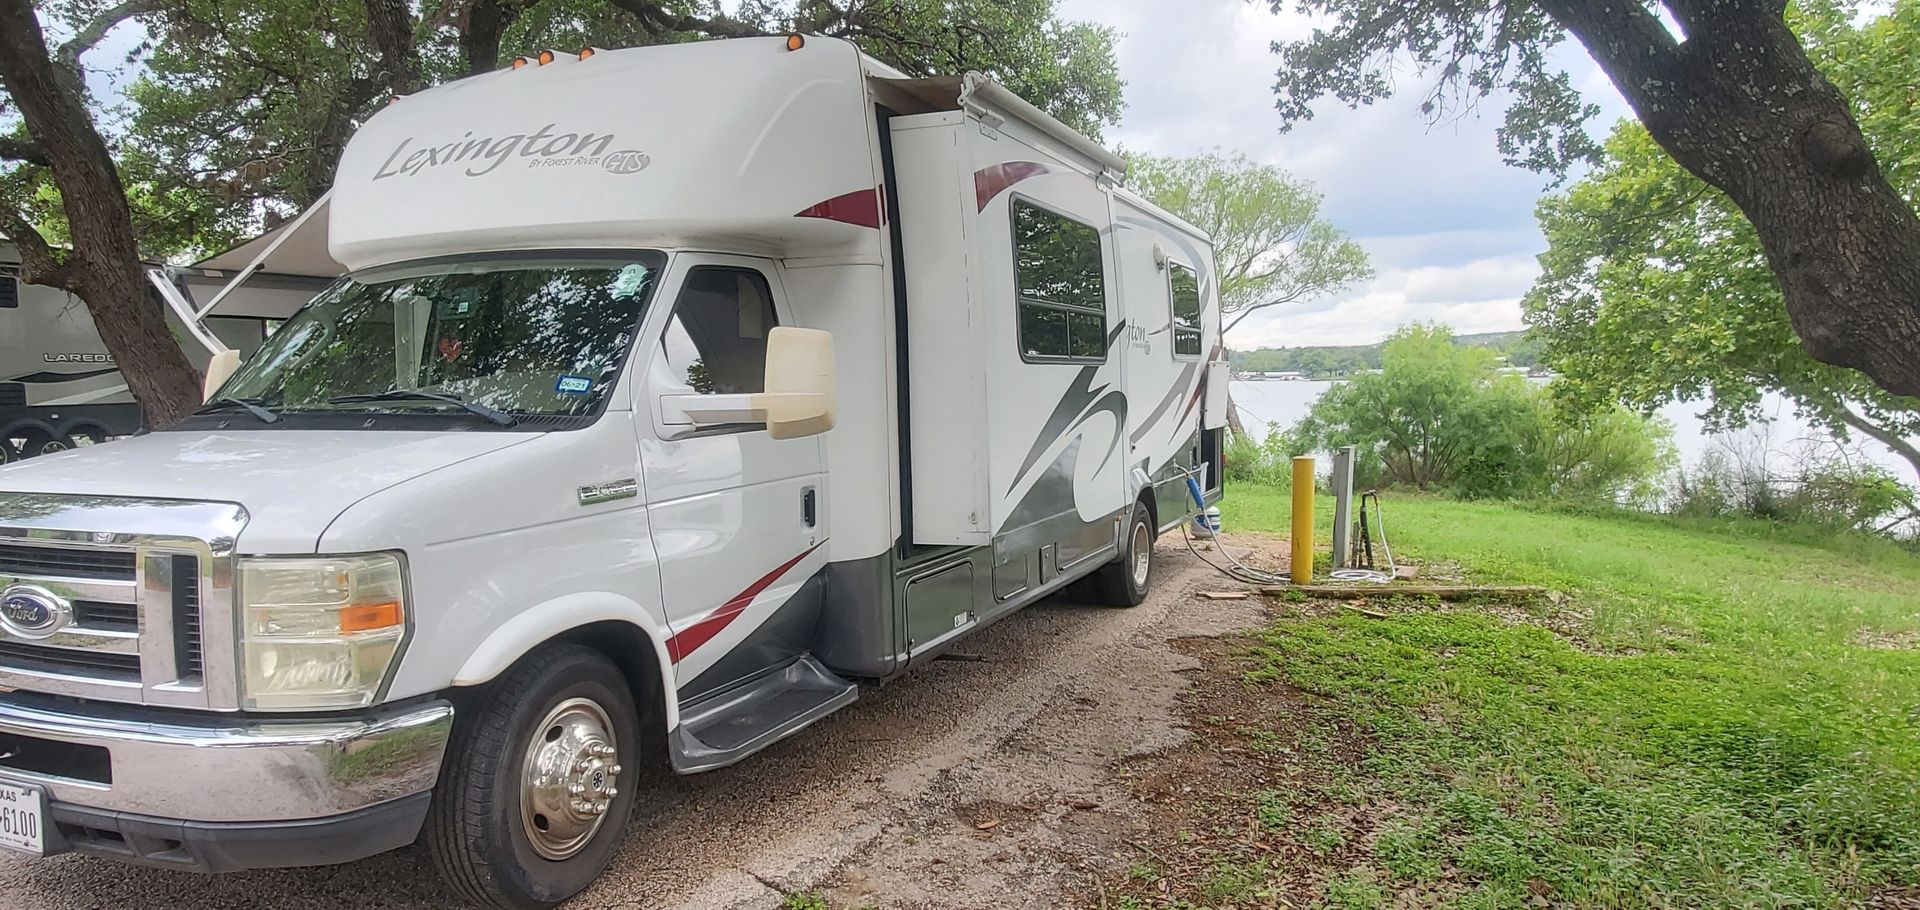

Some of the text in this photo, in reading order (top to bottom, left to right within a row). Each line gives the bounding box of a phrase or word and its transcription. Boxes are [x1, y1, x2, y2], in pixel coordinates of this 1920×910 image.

[372, 123, 615, 181] Lexington
[602, 150, 650, 174] GTS
[8, 599, 39, 622] Ford
